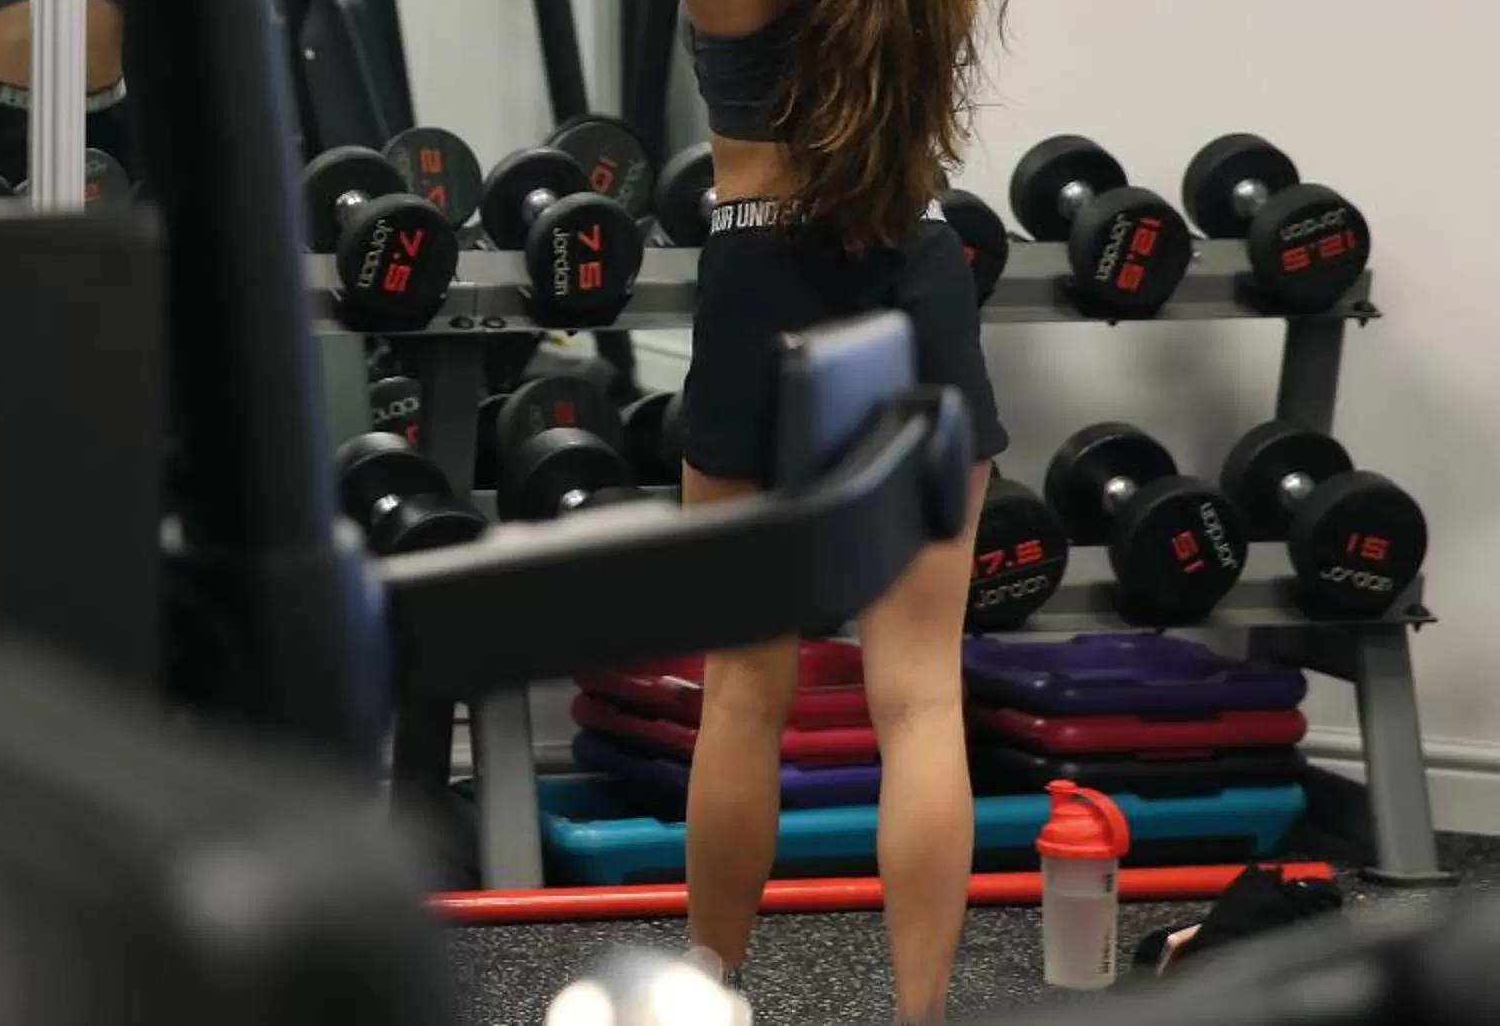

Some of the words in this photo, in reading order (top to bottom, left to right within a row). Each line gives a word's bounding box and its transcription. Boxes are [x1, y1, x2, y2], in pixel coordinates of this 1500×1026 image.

[356, 218, 395, 288] Jordan
[383, 228, 425, 293] 7.5
[552, 226, 572, 295] Jordan
[1115, 216, 1161, 291] 12.5
[1282, 229, 1356, 271] 12.5
[974, 538, 1044, 576] 7.5
[1171, 528, 1205, 574] 15
[1200, 501, 1238, 569] Jordan
[1346, 532, 1390, 562] 15
[1319, 564, 1395, 593] Jordan
